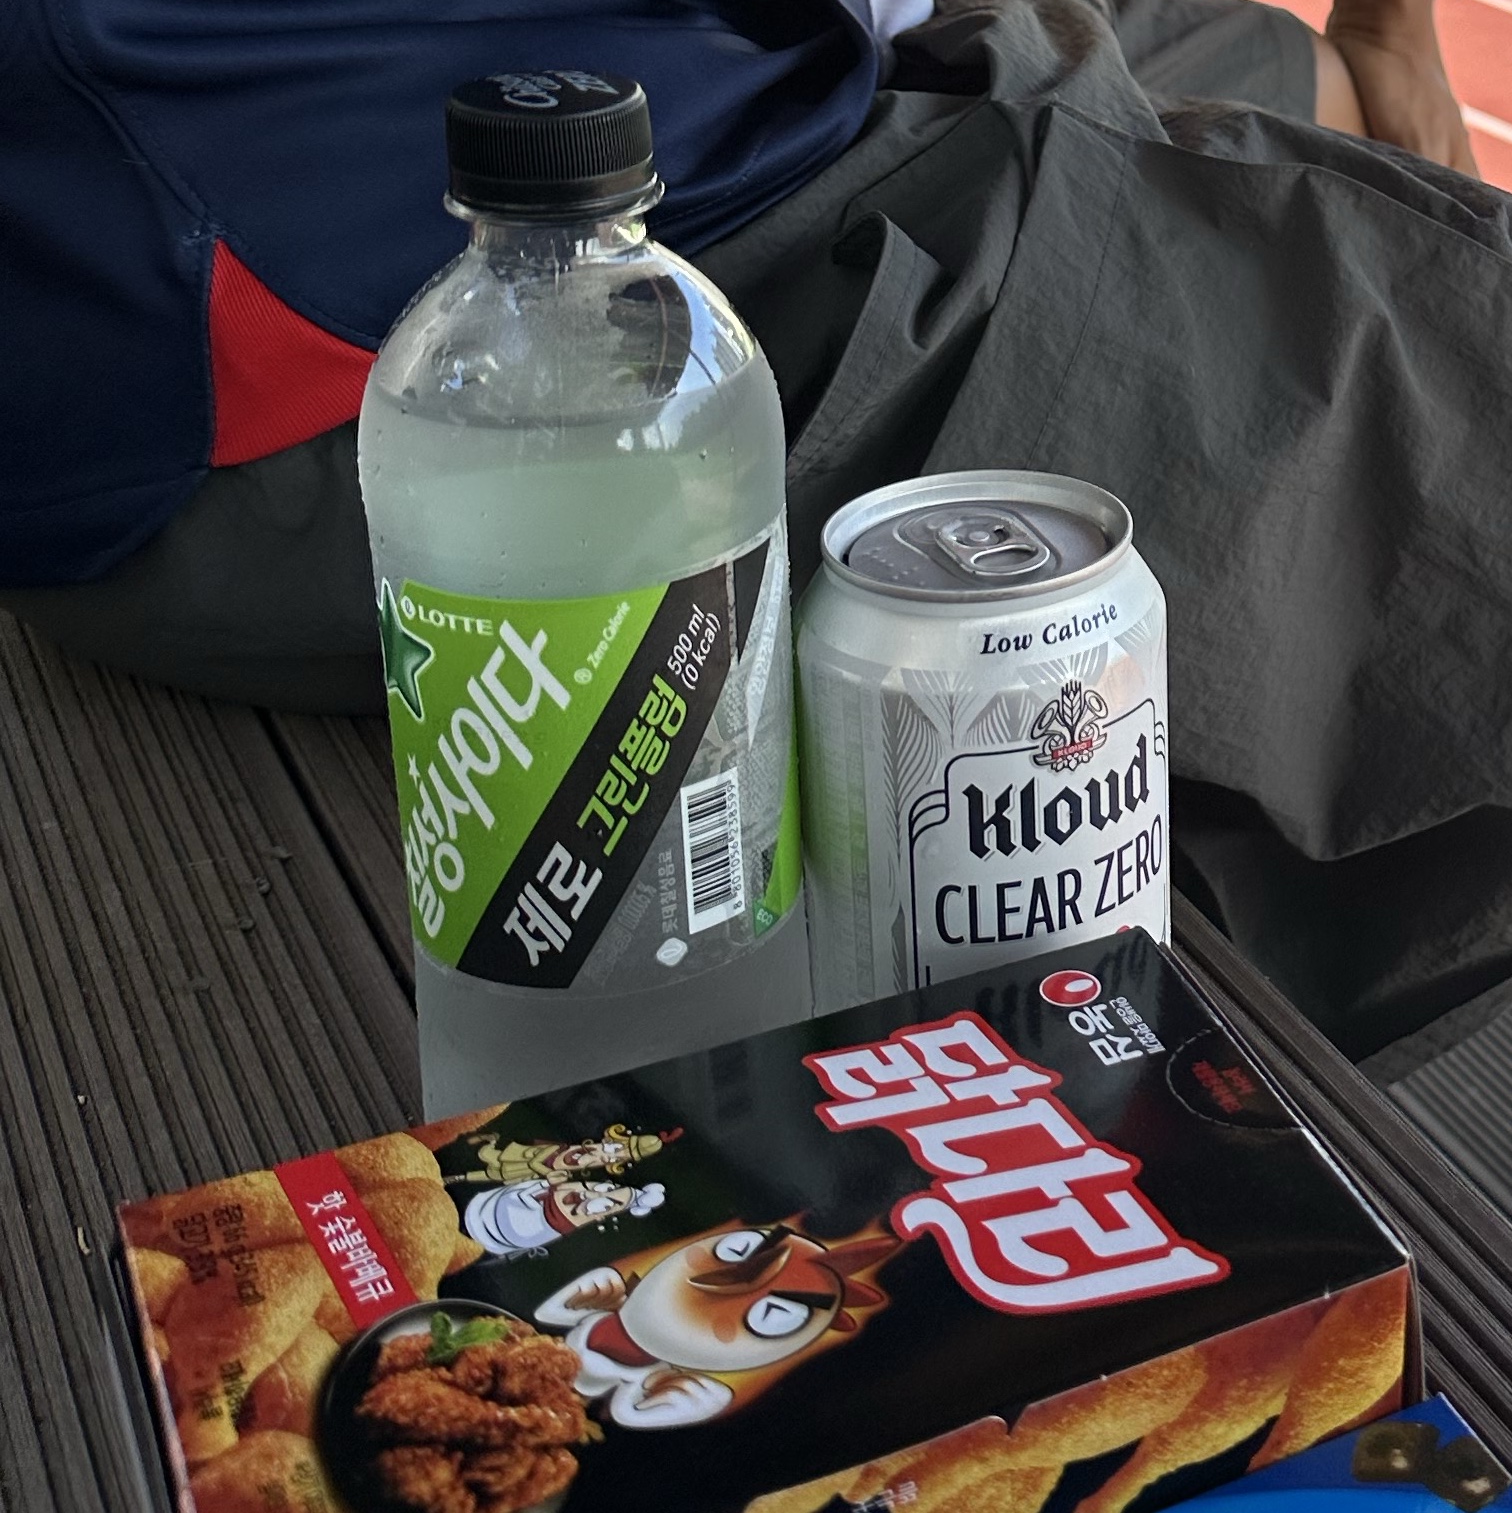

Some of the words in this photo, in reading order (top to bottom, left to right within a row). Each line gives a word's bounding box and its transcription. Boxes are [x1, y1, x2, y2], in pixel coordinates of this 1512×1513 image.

[418, 605, 494, 636] LOTTE
[667, 633, 692, 675] 500
[688, 603, 705, 636] ml
[691, 613, 721, 666] kcal)
[979, 632, 1033, 656] Low
[1041, 602, 1119, 647] Calorie
[404, 620, 571, 938] 칠성사이다
[962, 733, 1150, 861] Kloud
[503, 841, 602, 966] 제로
[576, 674, 688, 856] 그린플럼
[936, 867, 1083, 945] CLEAR
[1094, 815, 1163, 918] ZERO
[1068, 1003, 1143, 1065] 농심
[1109, 996, 1142, 1025] 인생을
[1130, 1022, 1167, 1054] 맛있게
[804, 1013, 1230, 1314] 닭다리
[305, 1190, 347, 1216] 핫
[318, 1215, 395, 1301] 숯불바베큐
